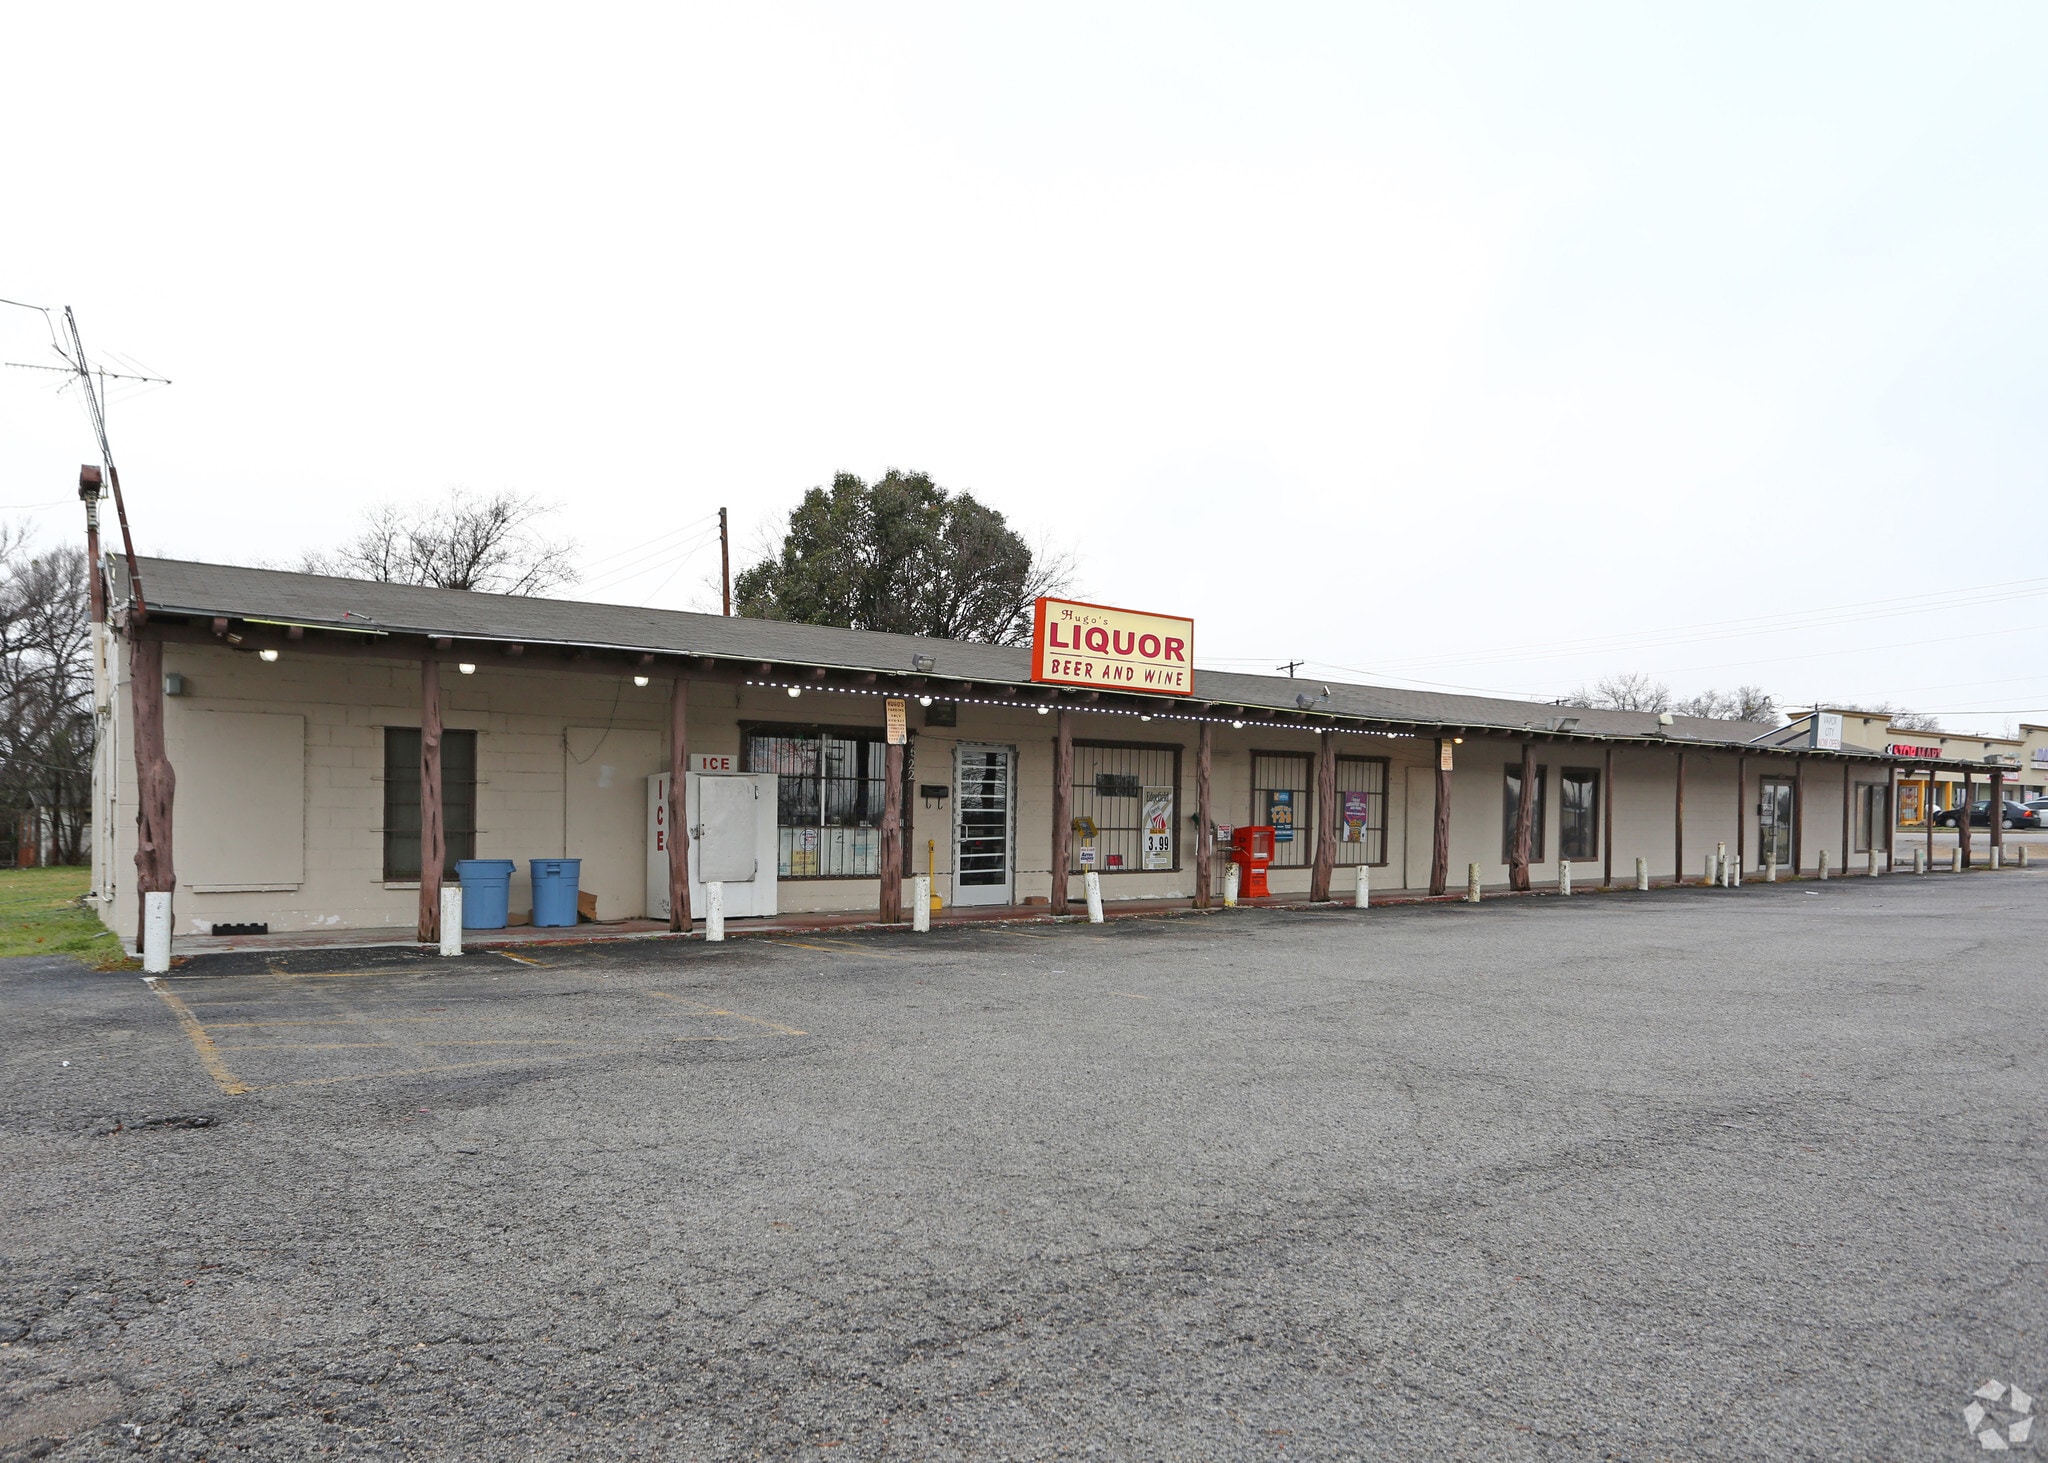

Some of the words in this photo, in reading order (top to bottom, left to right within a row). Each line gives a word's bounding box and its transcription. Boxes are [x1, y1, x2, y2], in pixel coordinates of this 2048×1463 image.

[1061, 609, 1109, 625] Hugo's
[1050, 622, 1185, 662] LIQUOR
[1051, 659, 1093, 679] BEER
[1102, 664, 1134, 681] AND
[1144, 668, 1184, 687] WINE
[1893, 745, 1917, 757] STOP
[702, 757, 730, 770] ICE
[1148, 836, 1169, 851] 3.99
